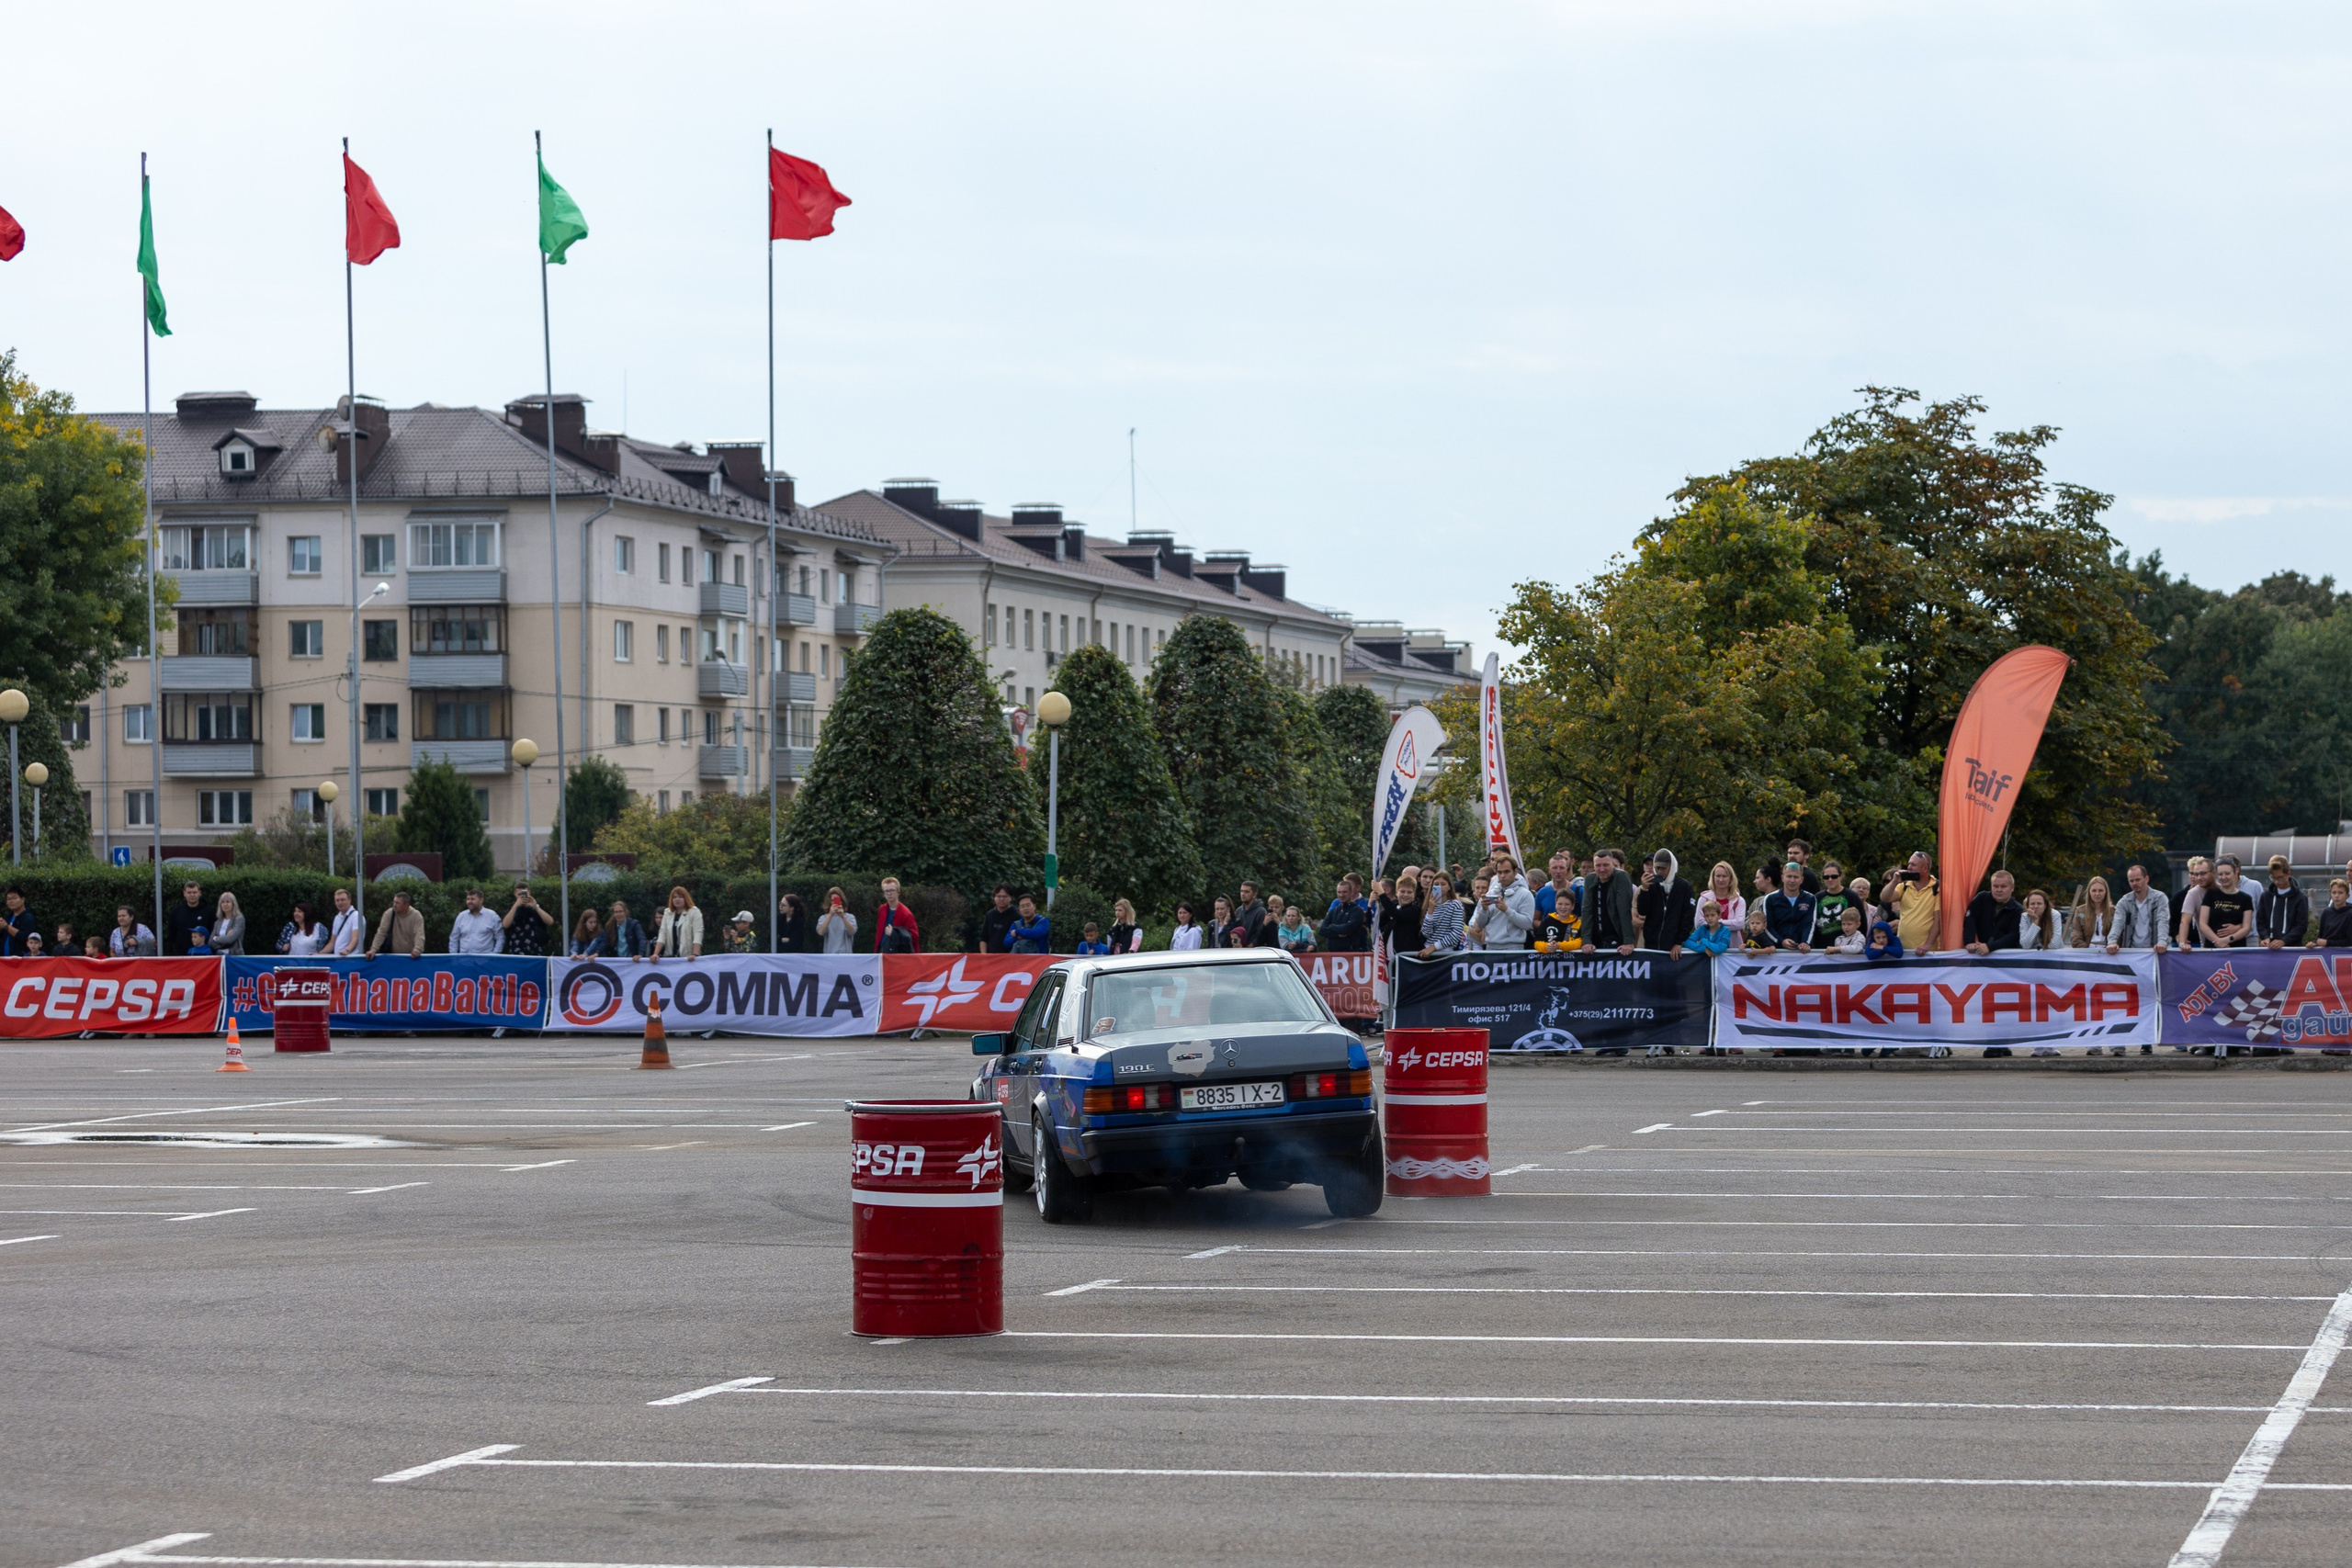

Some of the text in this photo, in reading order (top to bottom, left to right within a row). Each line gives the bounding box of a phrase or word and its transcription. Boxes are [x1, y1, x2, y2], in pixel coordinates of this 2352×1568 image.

[1488, 686, 1510, 849] KAYAMA
[1965, 757, 2013, 802] Taif
[1965, 792, 1994, 812] lubcants
[1452, 960, 1651, 983] ПОДШИПНИКИ
[4, 976, 196, 1021] CEPSA
[232, 970, 540, 1016] #GkhanaBattle
[1733, 982, 2139, 1024] NAKAYAMA
[2177, 961, 2238, 1023] ADT.BY
[1452, 1004, 1532, 1014] Тимирязева 121/4
[1468, 1014, 1510, 1024] офис 517
[1118, 1064, 1155, 1073] 190 E
[1425, 1051, 1484, 1067] CEPSA
[1196, 1087, 1235, 1105] 8835
